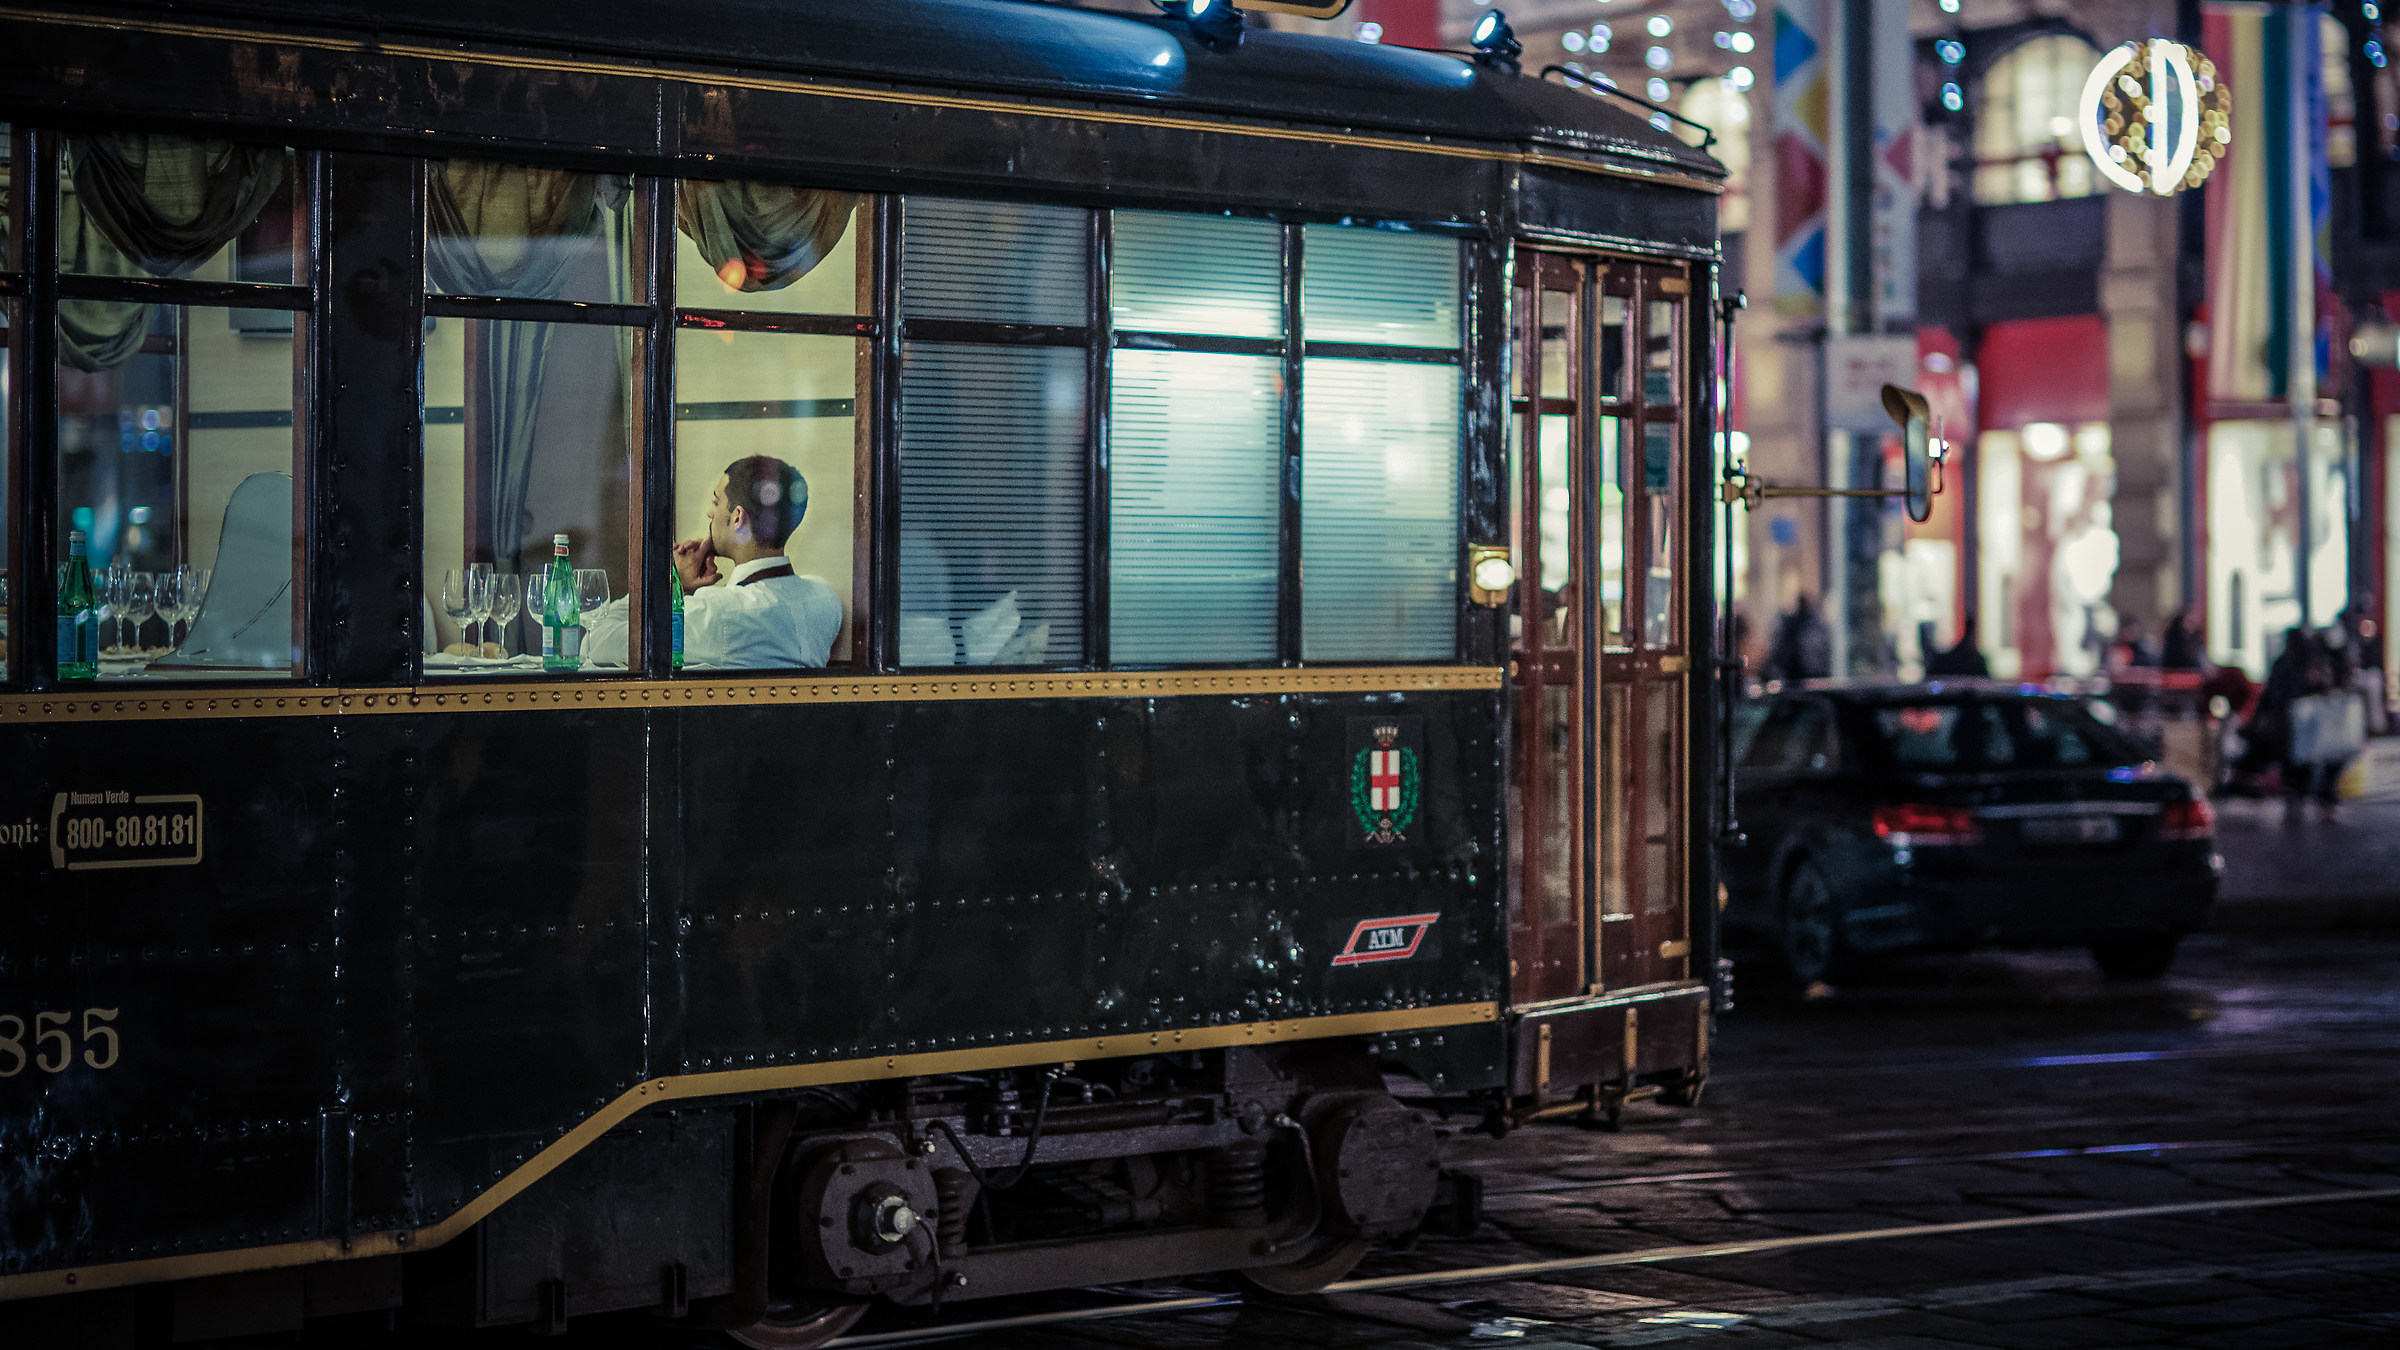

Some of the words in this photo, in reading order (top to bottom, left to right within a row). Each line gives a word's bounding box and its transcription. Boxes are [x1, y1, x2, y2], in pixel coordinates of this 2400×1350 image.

[70, 792, 103, 804] Numero
[105, 790, 129, 803] Verde
[1368, 928, 1404, 949] ATM
[0, 1007, 119, 1077] 855
